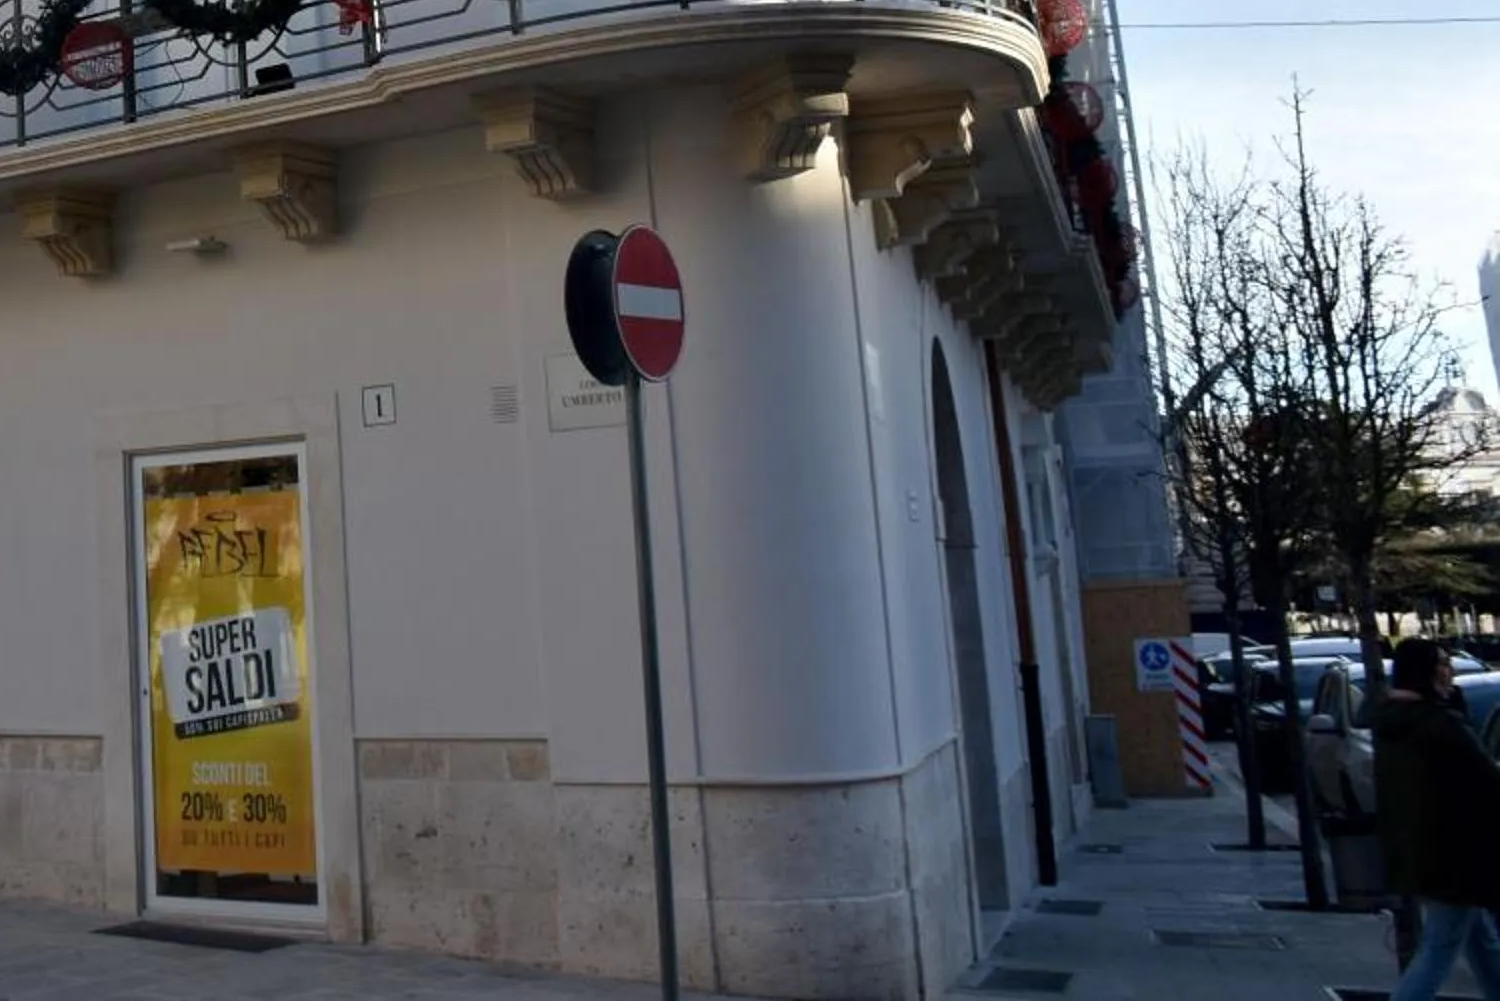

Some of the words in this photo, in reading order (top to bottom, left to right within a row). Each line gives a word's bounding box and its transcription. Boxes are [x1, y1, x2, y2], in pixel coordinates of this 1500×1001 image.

[188, 617, 257, 662] SUPER
[185, 648, 277, 714] SALDI
[192, 761, 241, 785] SCONTI
[245, 761, 272, 786] DEL
[181, 791, 223, 822] 20%
[228, 798, 238, 822] E
[243, 792, 287, 825] 30%
